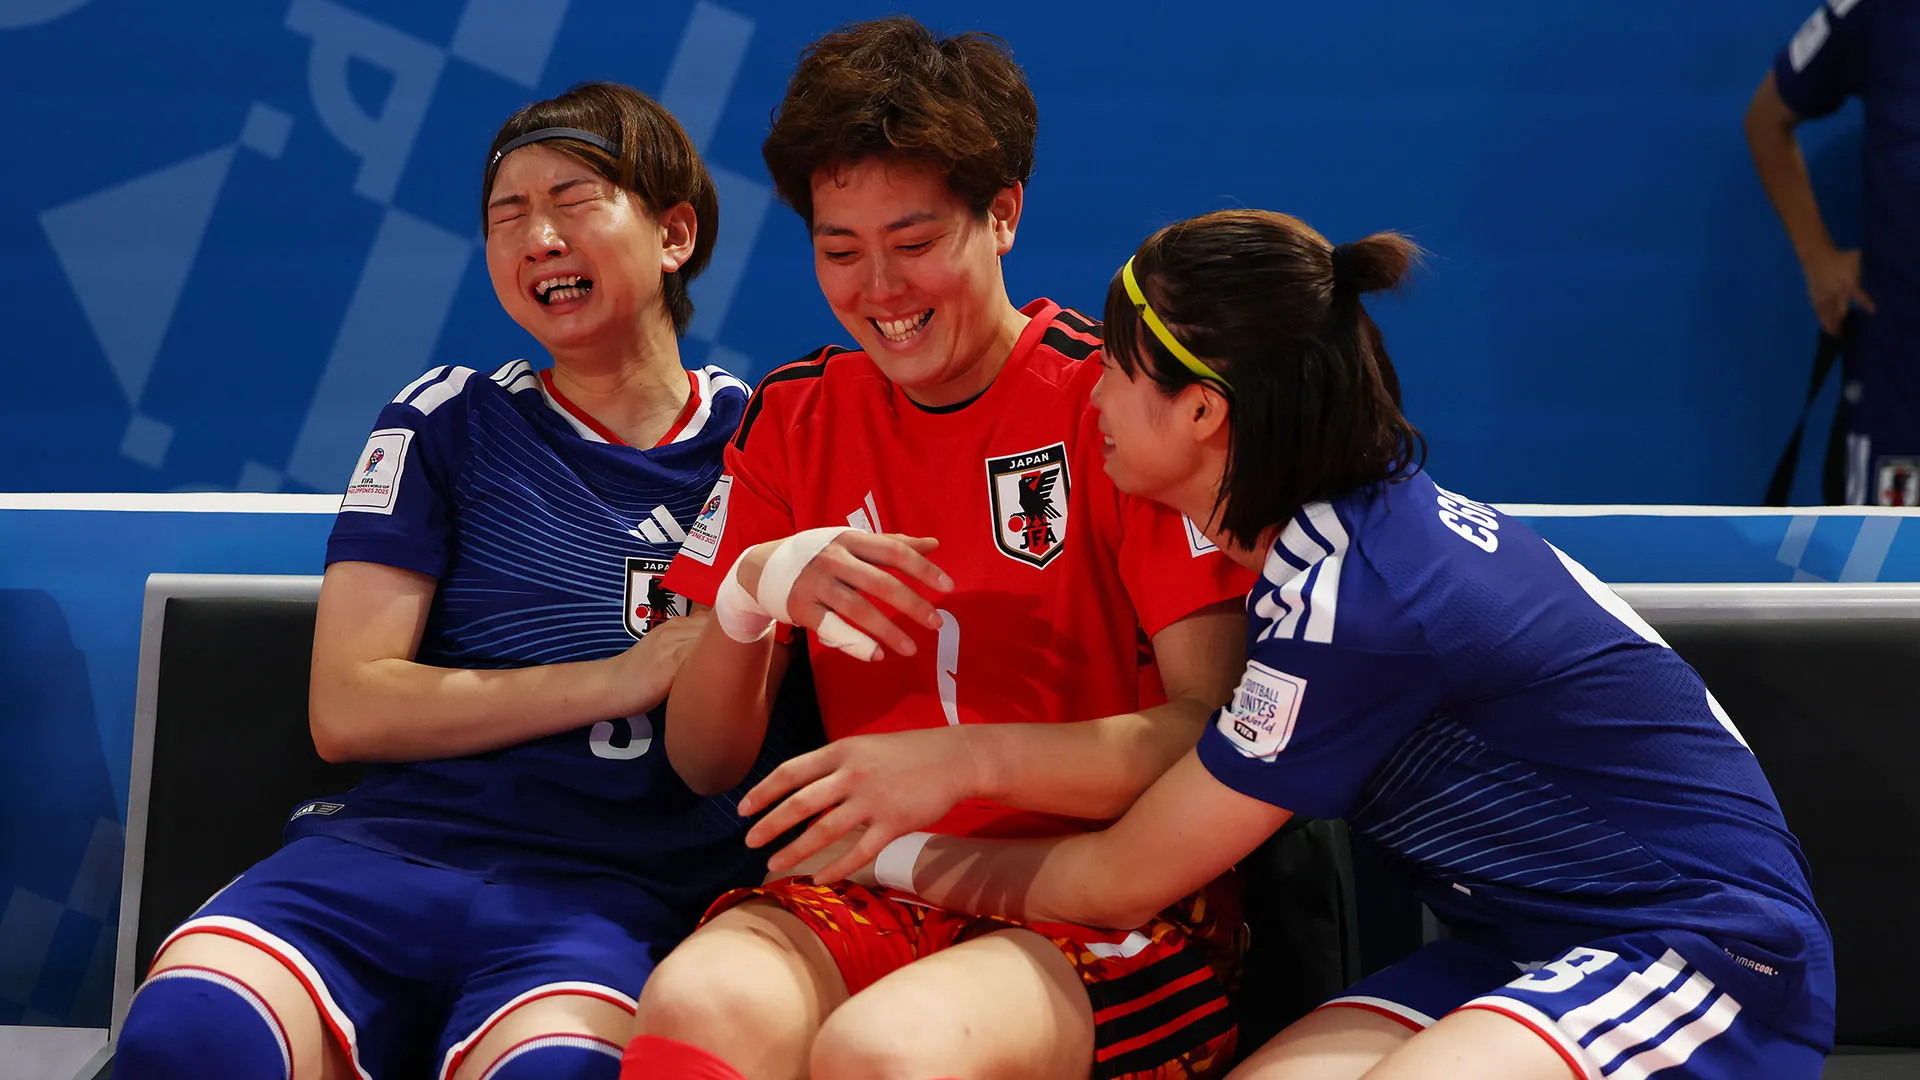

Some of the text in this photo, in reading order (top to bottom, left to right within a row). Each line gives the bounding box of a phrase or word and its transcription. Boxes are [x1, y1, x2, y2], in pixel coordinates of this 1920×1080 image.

[1009, 452, 1050, 469] JAPAN
[694, 521, 707, 531] FIFA
[1020, 527, 1058, 549] JFA
[643, 562, 670, 571] JAPA
[1240, 691, 1277, 719] UNITES
[1236, 722, 1255, 741] FIFA
